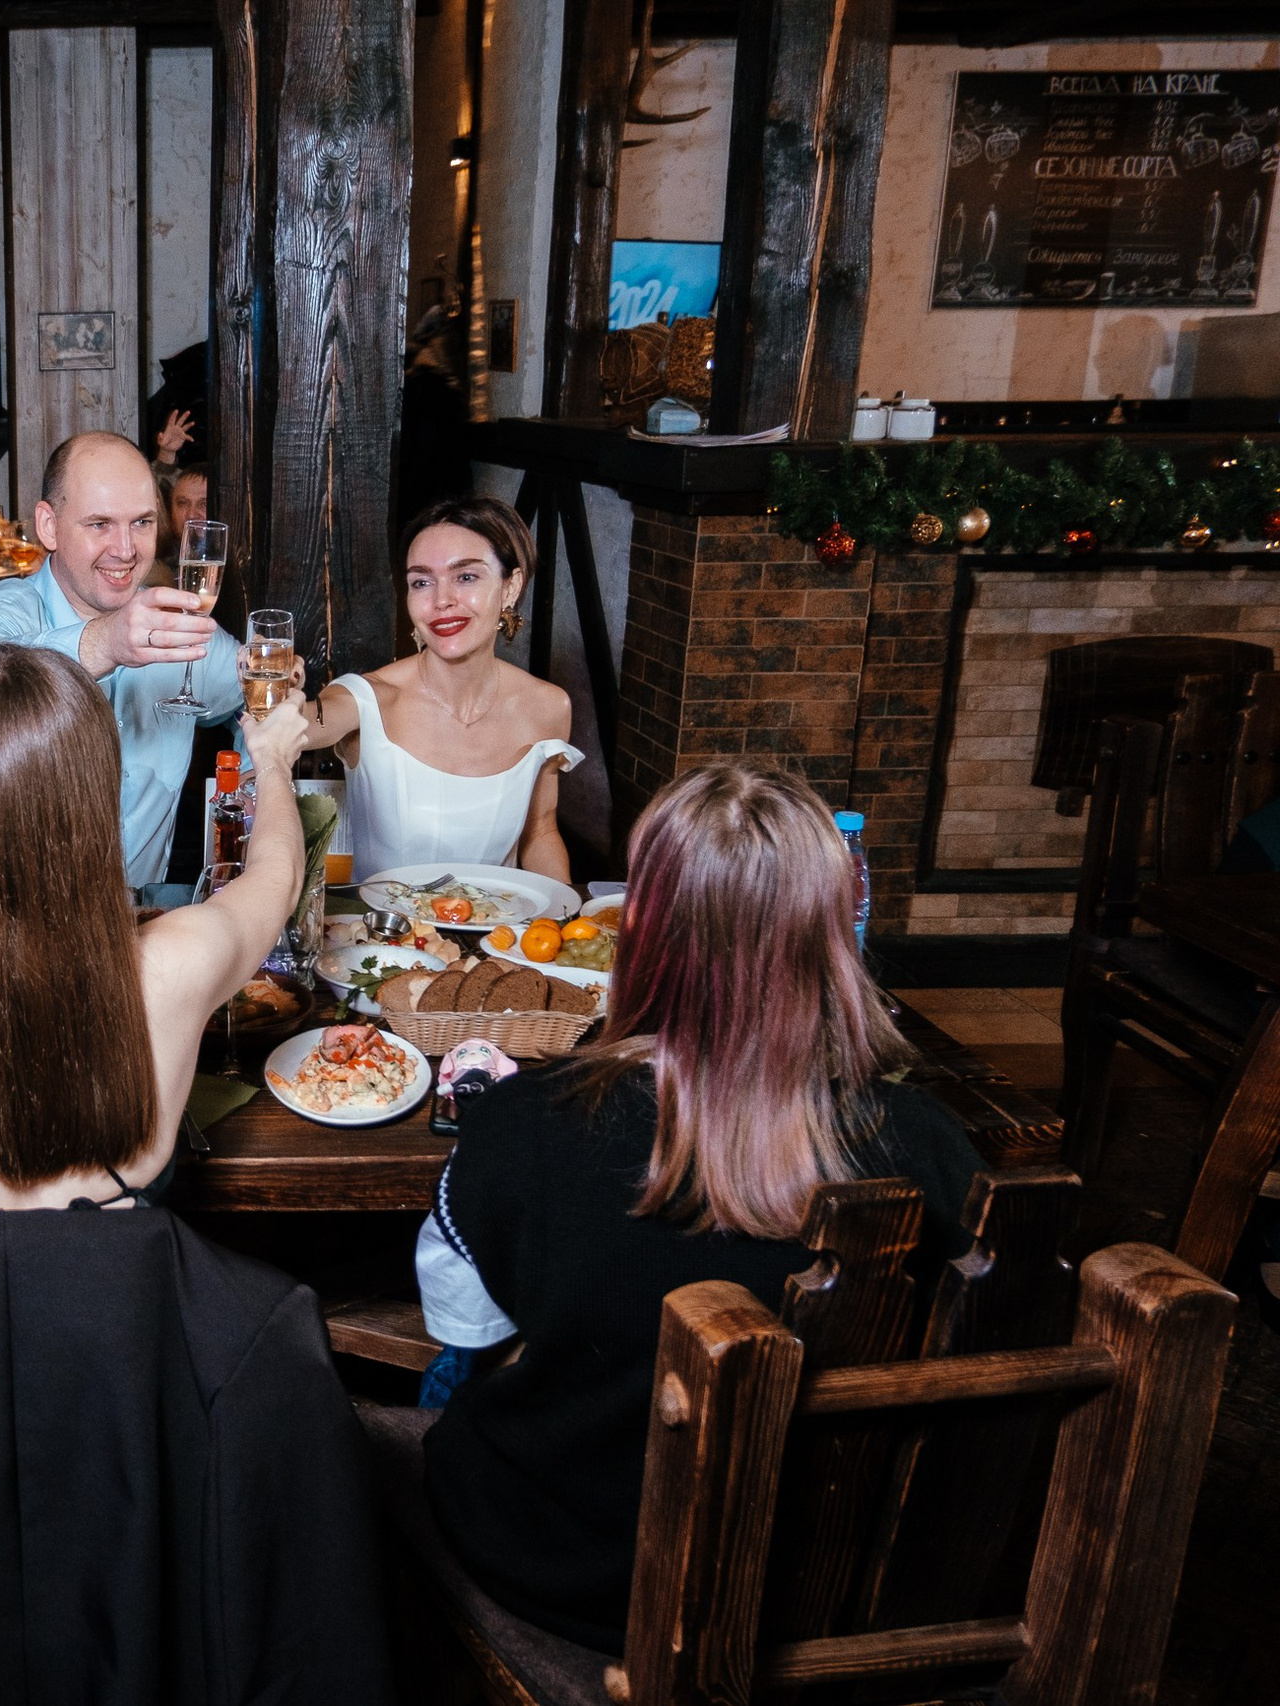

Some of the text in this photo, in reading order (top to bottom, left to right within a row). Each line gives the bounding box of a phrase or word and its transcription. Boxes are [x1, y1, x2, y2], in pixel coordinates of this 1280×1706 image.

[1050, 73, 1221, 94] ВСЕГДА НА КРАНЕ
[1122, 155, 1178, 178] СОРТА
